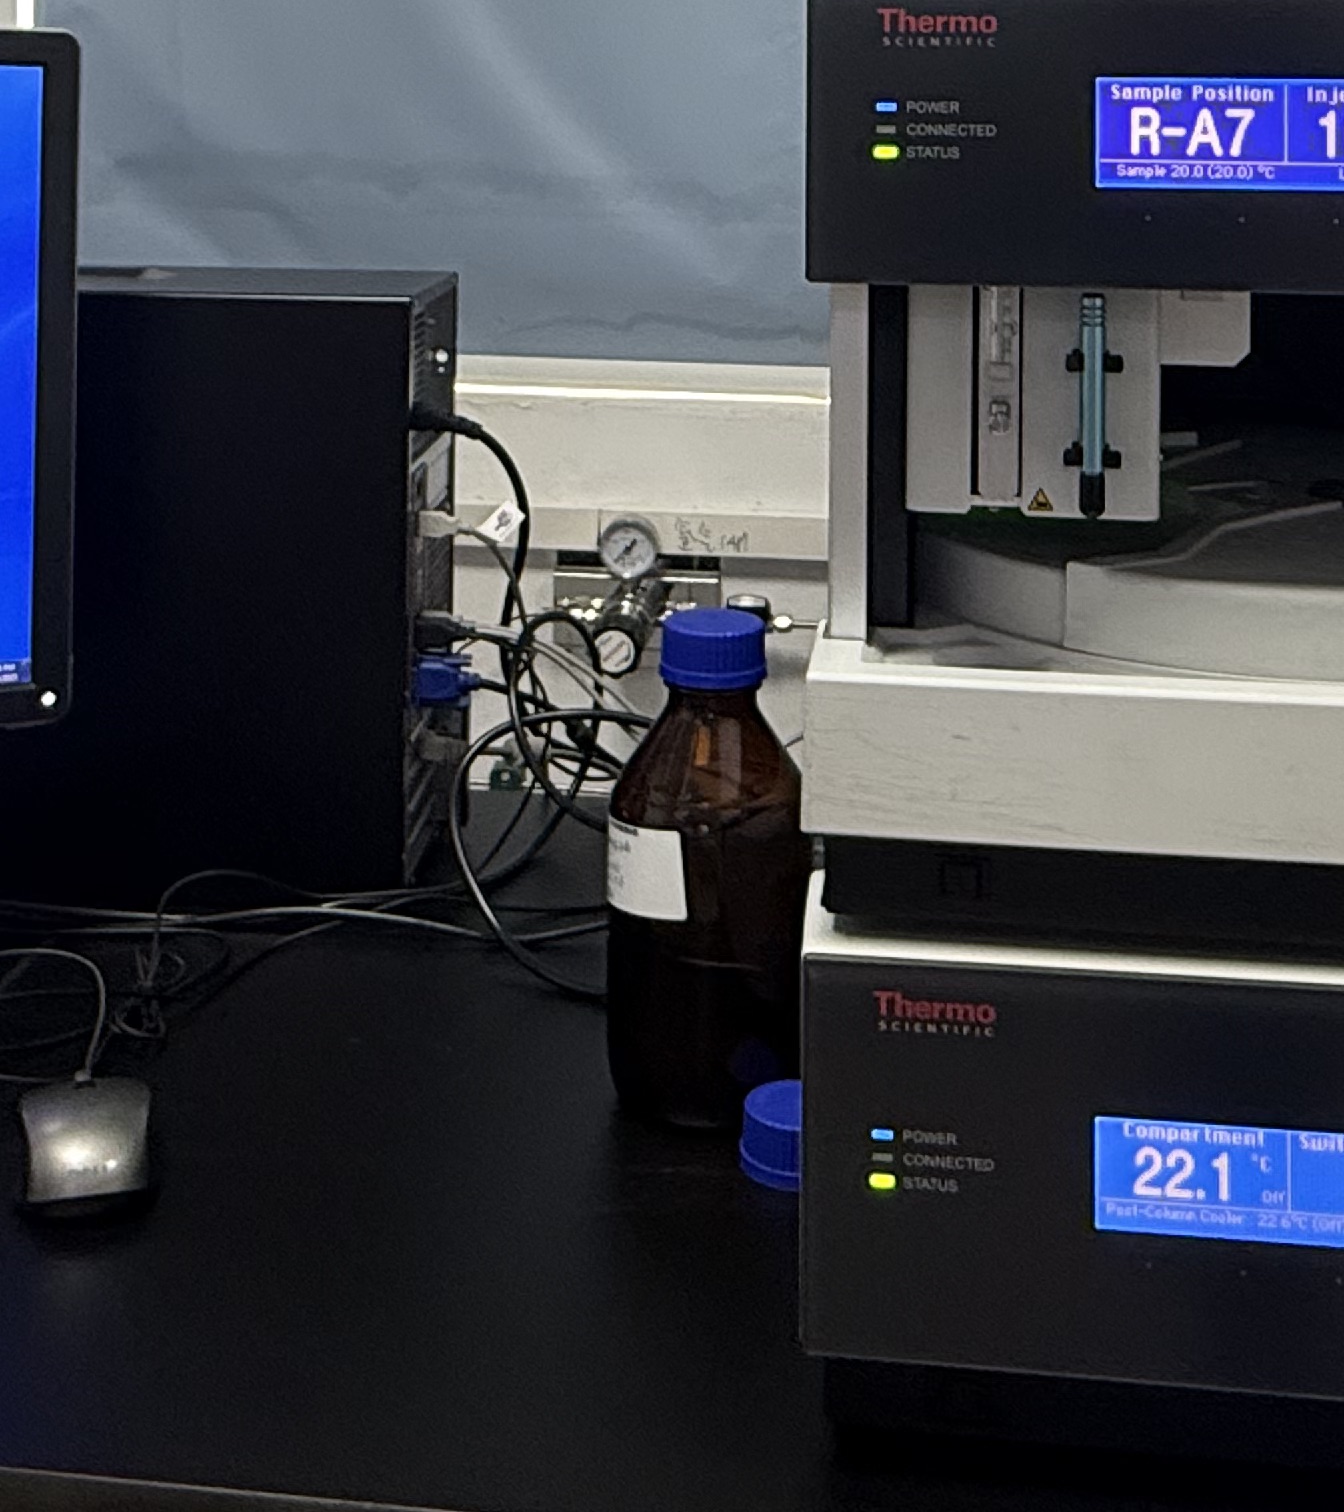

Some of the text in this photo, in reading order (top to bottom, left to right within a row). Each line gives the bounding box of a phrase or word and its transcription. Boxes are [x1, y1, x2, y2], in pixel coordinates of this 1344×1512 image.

[877, 8, 998, 34] Thermo
[882, 37, 996, 47] SCIENTIFIC
[1111, 85, 1275, 103] Sample Position
[907, 101, 960, 113] POWER
[907, 124, 997, 136] CONNECTED
[1130, 106, 1256, 158] R-A7
[907, 146, 960, 159] STATUS
[1116, 163, 1166, 179] Sample
[1170, 164, 1204, 178] 20.0
[873, 990, 997, 1024] Thermo
[878, 1021, 995, 1037] SCIENTIFIC
[903, 1129, 957, 1145] POWER
[1123, 1121, 1264, 1146] Compartment
[903, 1152, 995, 1172] CONNECTED
[1133, 1146, 1229, 1201] 22.1
[903, 1177, 959, 1193] STATUS
